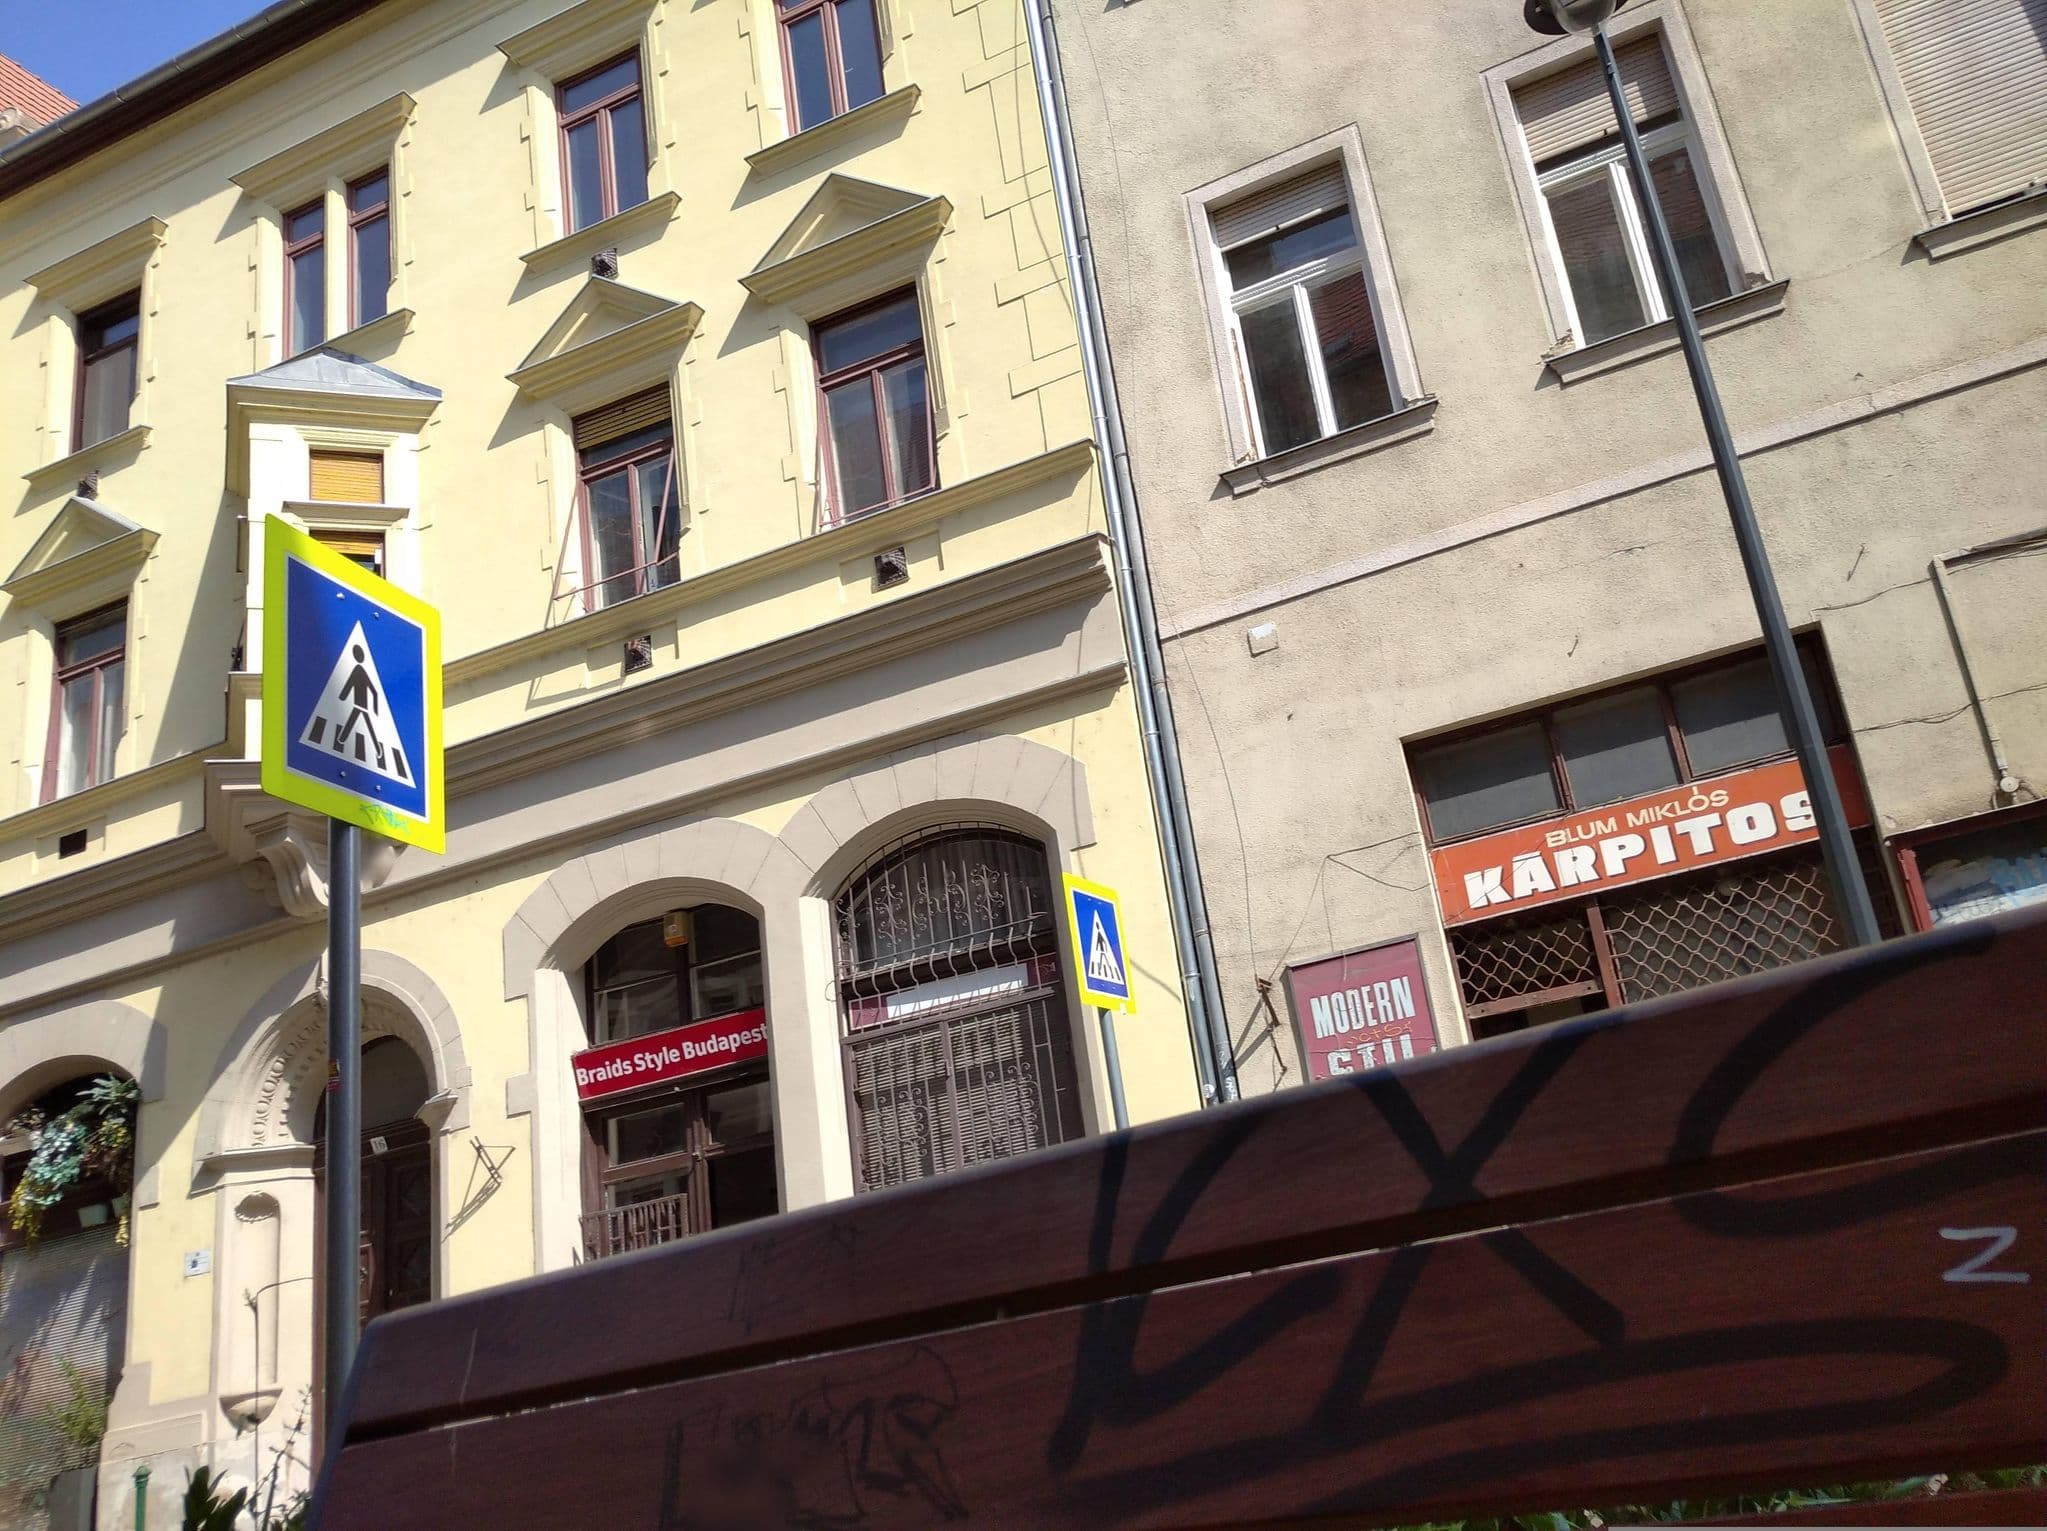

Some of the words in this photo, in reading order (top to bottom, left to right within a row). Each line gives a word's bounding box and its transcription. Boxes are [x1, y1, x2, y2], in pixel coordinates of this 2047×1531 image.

[1545, 816, 1617, 848] BLUM
[1626, 786, 1730, 828] MIKLÓS
[1463, 790, 1818, 909] KÁRPITOS
[1310, 976, 1416, 1039] MODERN
[576, 1058, 633, 1086] Braids
[633, 1047, 681, 1072] Style
[682, 1023, 768, 1060] Budapest
